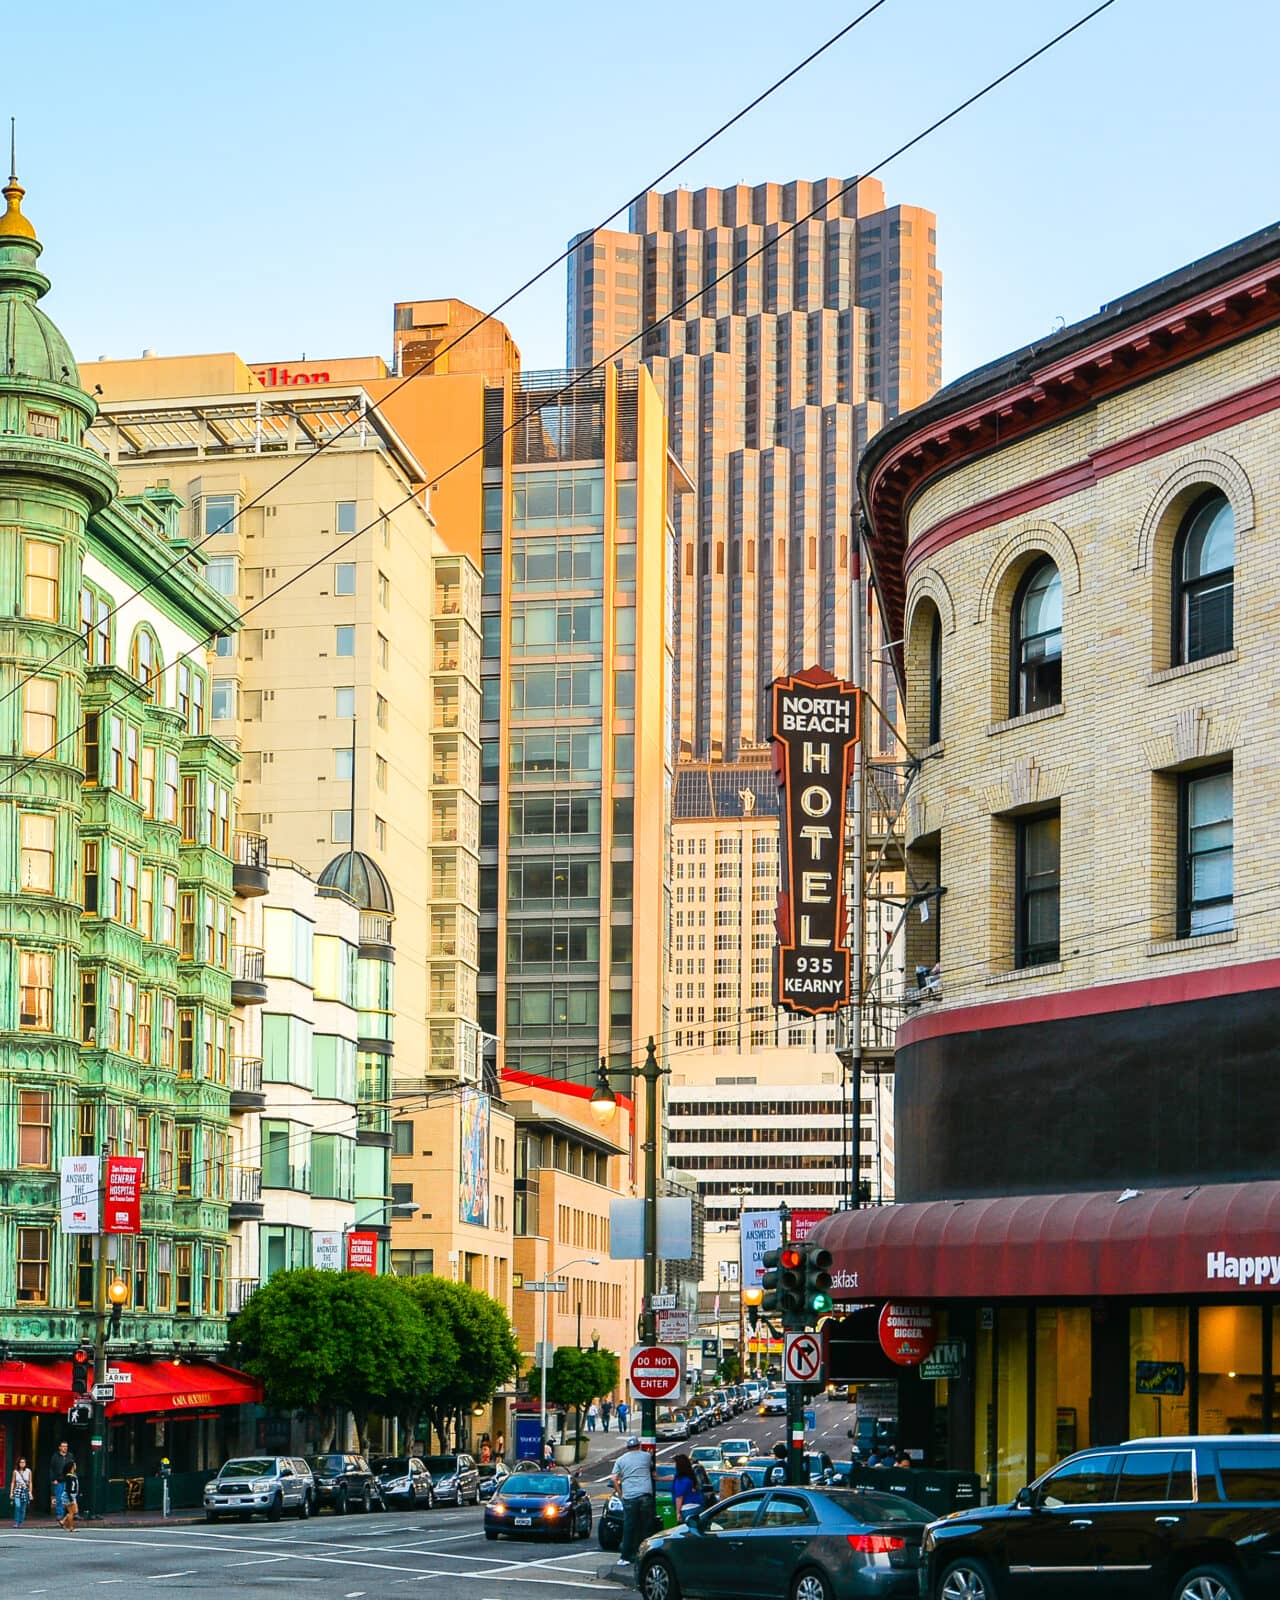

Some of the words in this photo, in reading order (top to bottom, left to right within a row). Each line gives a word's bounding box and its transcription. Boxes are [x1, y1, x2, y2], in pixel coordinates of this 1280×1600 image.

[253, 367, 330, 386] ilton
[783, 697, 849, 717] NORTH
[783, 715, 849, 734] BEACH
[800, 742, 833, 947] HOTEL
[797, 958, 833, 975] 935
[784, 977, 844, 994] KEARNY
[73, 1163, 87, 1172] WHO
[66, 1173, 93, 1184] ANSWERS
[110, 1173, 136, 1184] GENERAL
[74, 1184, 84, 1194] THE
[109, 1185, 135, 1196] HOSPITAL
[753, 1219, 768, 1229] WHO
[746, 1229, 776, 1240] ANSWERS
[756, 1240, 767, 1250] THE
[1207, 1251, 1280, 1285] Happy
[886, 1316, 932, 1328] SOMETHING
[893, 1328, 924, 1339] BIGGER.
[922, 1344, 959, 1364] ATM
[637, 1358, 650, 1366] DO
[655, 1357, 673, 1366] NOT
[640, 1380, 669, 1388] ENTER
